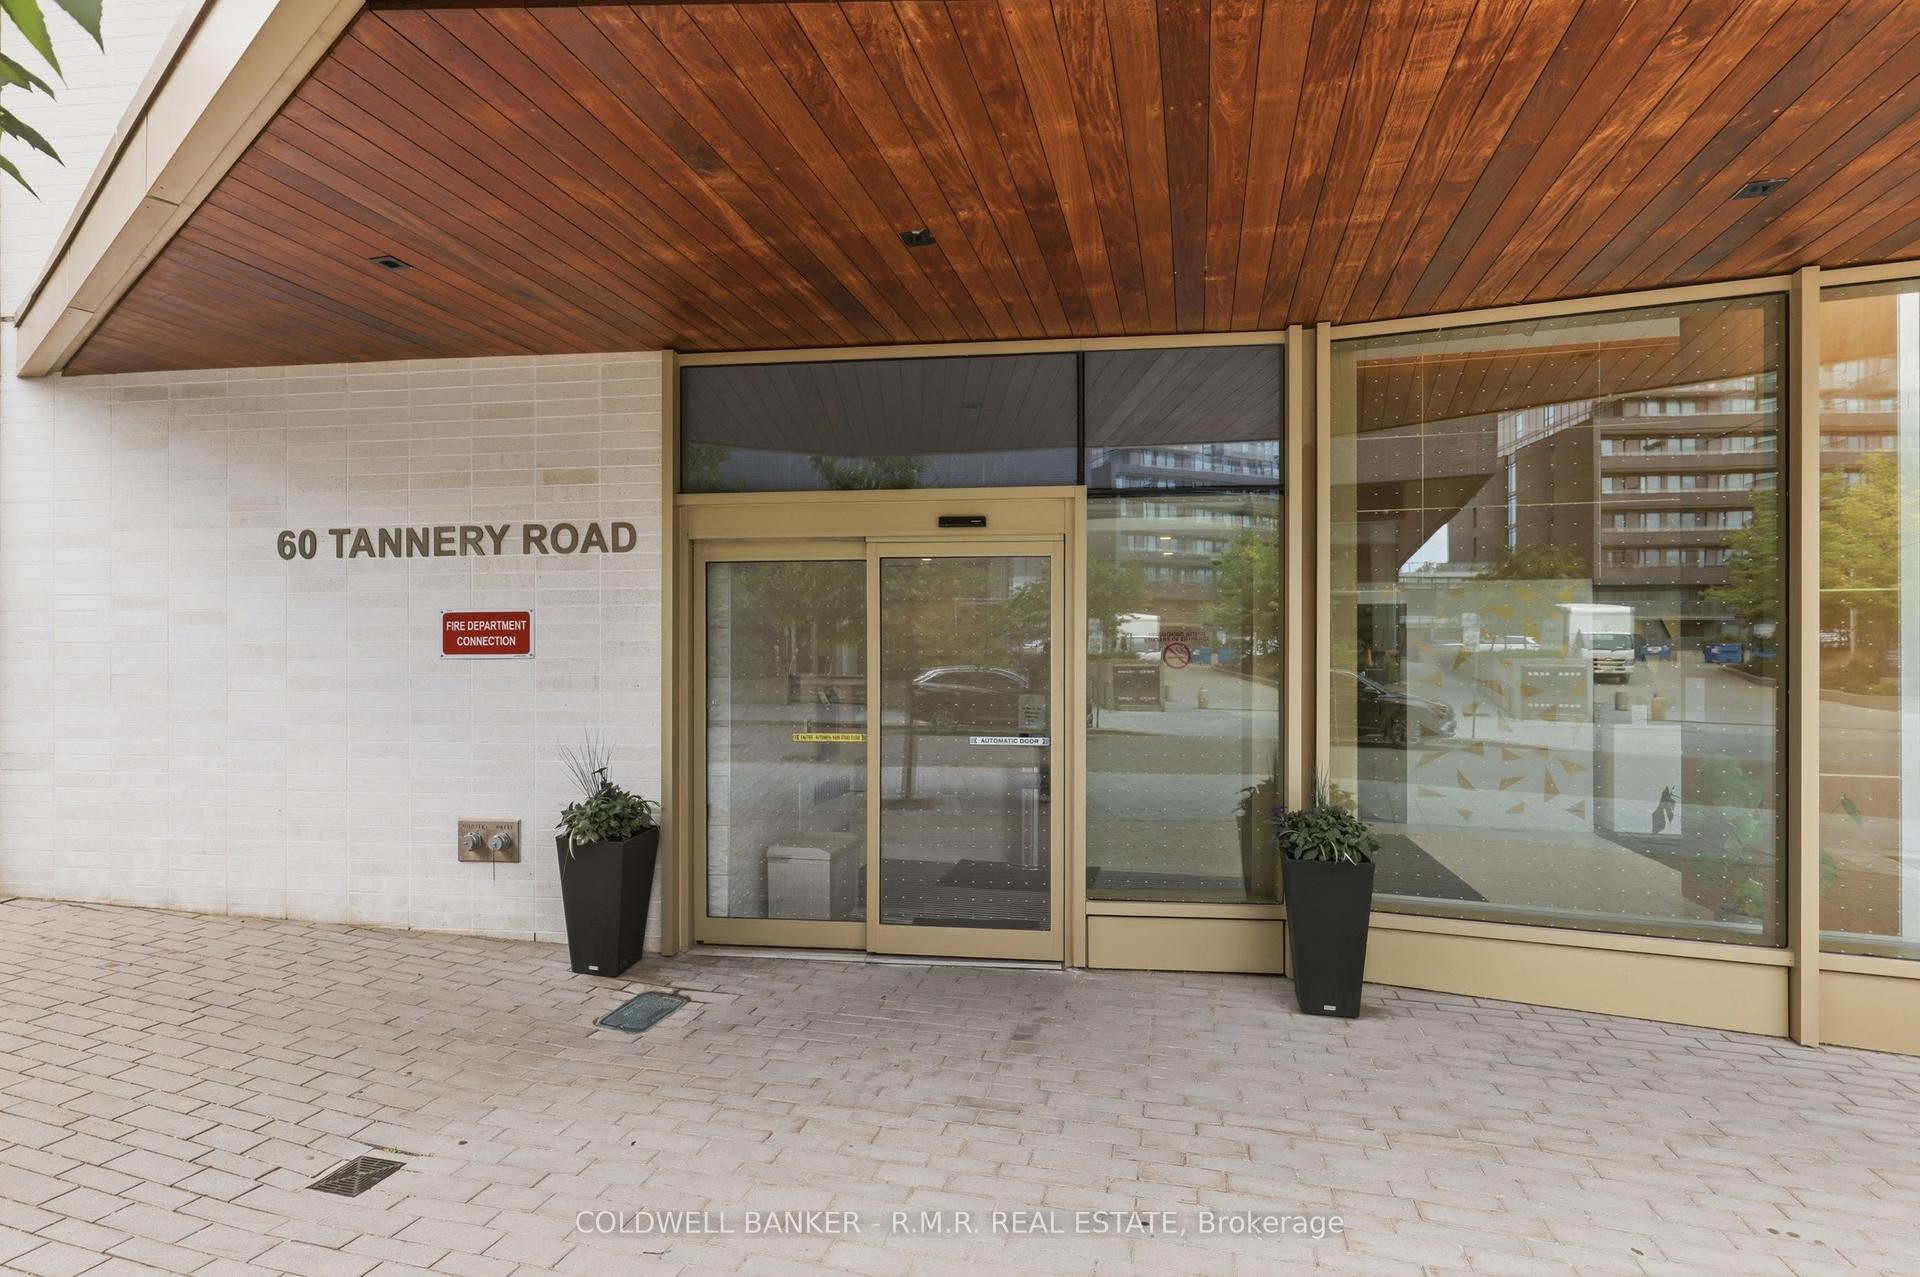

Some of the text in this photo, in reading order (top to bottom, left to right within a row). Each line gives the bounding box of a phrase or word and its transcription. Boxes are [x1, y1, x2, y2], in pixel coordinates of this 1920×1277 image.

[276, 521, 638, 560] 60 TANNERY ROAD
[446, 620, 527, 632] FIRE DEPARTMENT
[456, 636, 516, 647] CONNECTION
